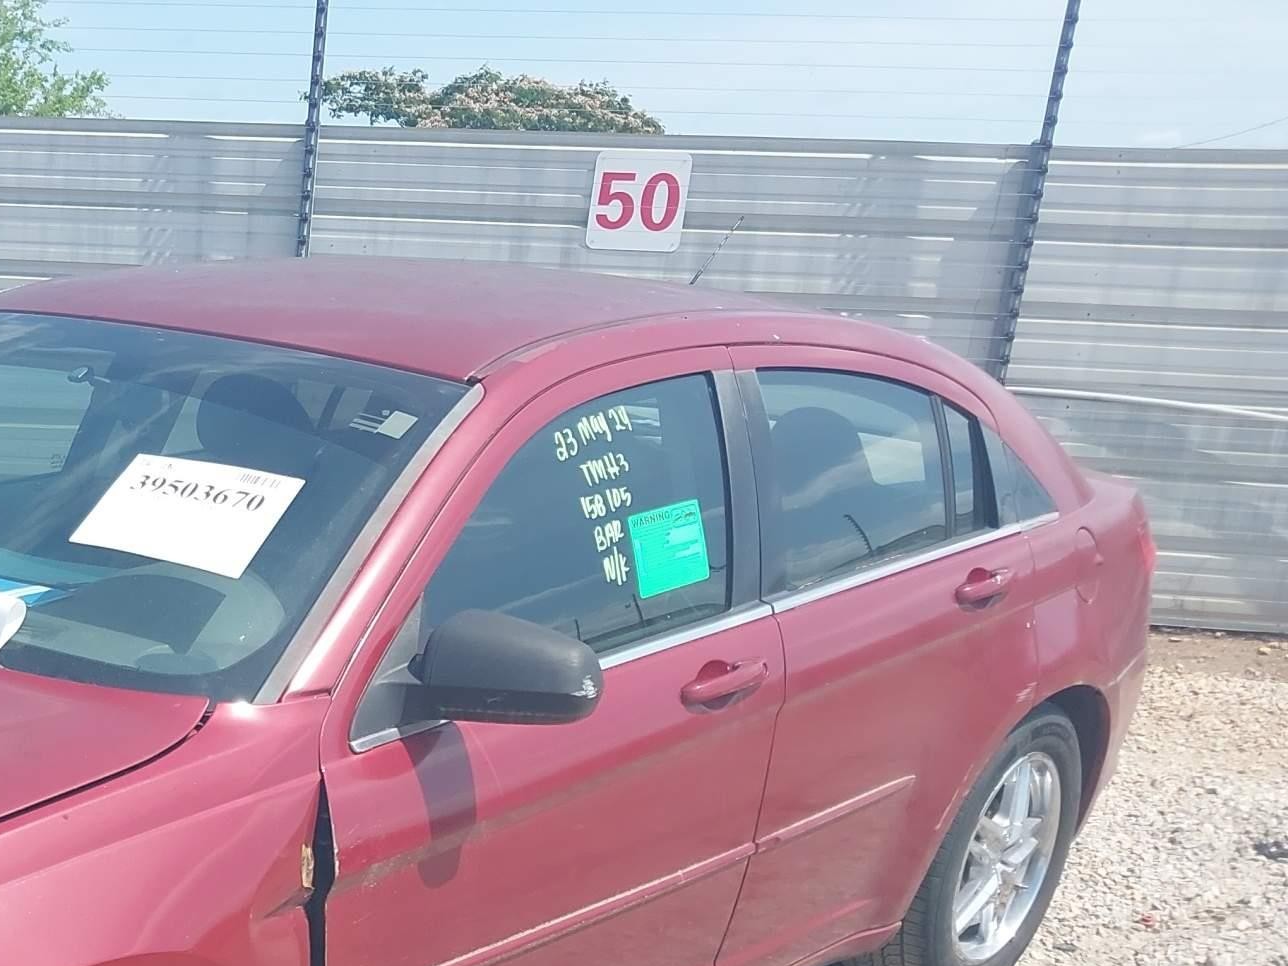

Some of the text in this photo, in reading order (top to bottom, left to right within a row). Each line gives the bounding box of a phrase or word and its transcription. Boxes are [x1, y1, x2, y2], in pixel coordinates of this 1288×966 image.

[595, 171, 681, 232] 50
[554, 428, 578, 461] 23
[608, 405, 632, 431] 24
[129, 474, 266, 512] 39503670
[594, 519, 625, 552] BAR
[631, 510, 670, 528] WARNING
